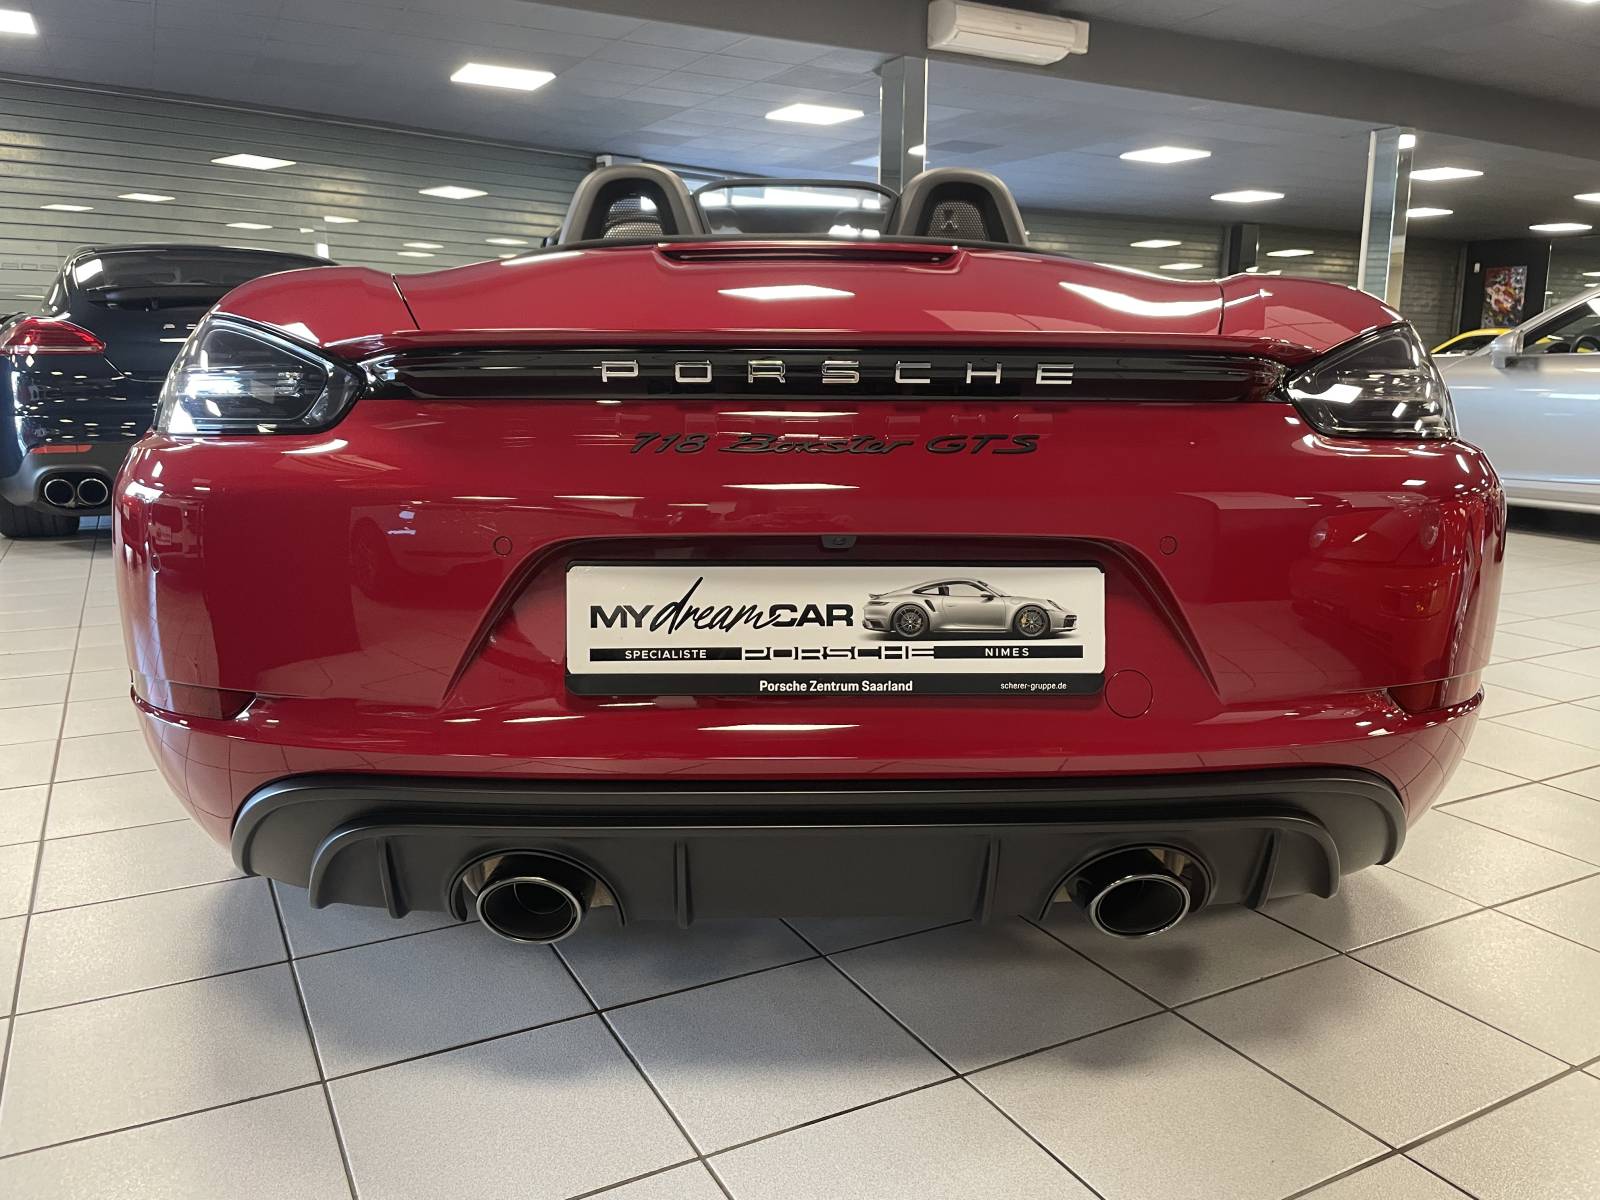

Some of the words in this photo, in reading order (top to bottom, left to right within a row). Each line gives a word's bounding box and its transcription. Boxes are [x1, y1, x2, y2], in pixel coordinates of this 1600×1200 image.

[601, 360, 1074, 384] PORSCHE
[630, 432, 709, 454] 718
[719, 433, 914, 454] Boxster
[926, 434, 1041, 455] GTS
[590, 604, 655, 629] MY
[649, 576, 782, 635] dream
[768, 603, 854, 628] CAR
[624, 649, 708, 660] SPECIALISTE
[741, 646, 935, 661] PORSCHE
[984, 647, 1031, 658] NIMES
[759, 680, 807, 693] Porsche
[808, 680, 860, 693] Zentrum
[861, 679, 914, 693] Saarland
[1000, 681, 1068, 692] scherer-gruppe.de
